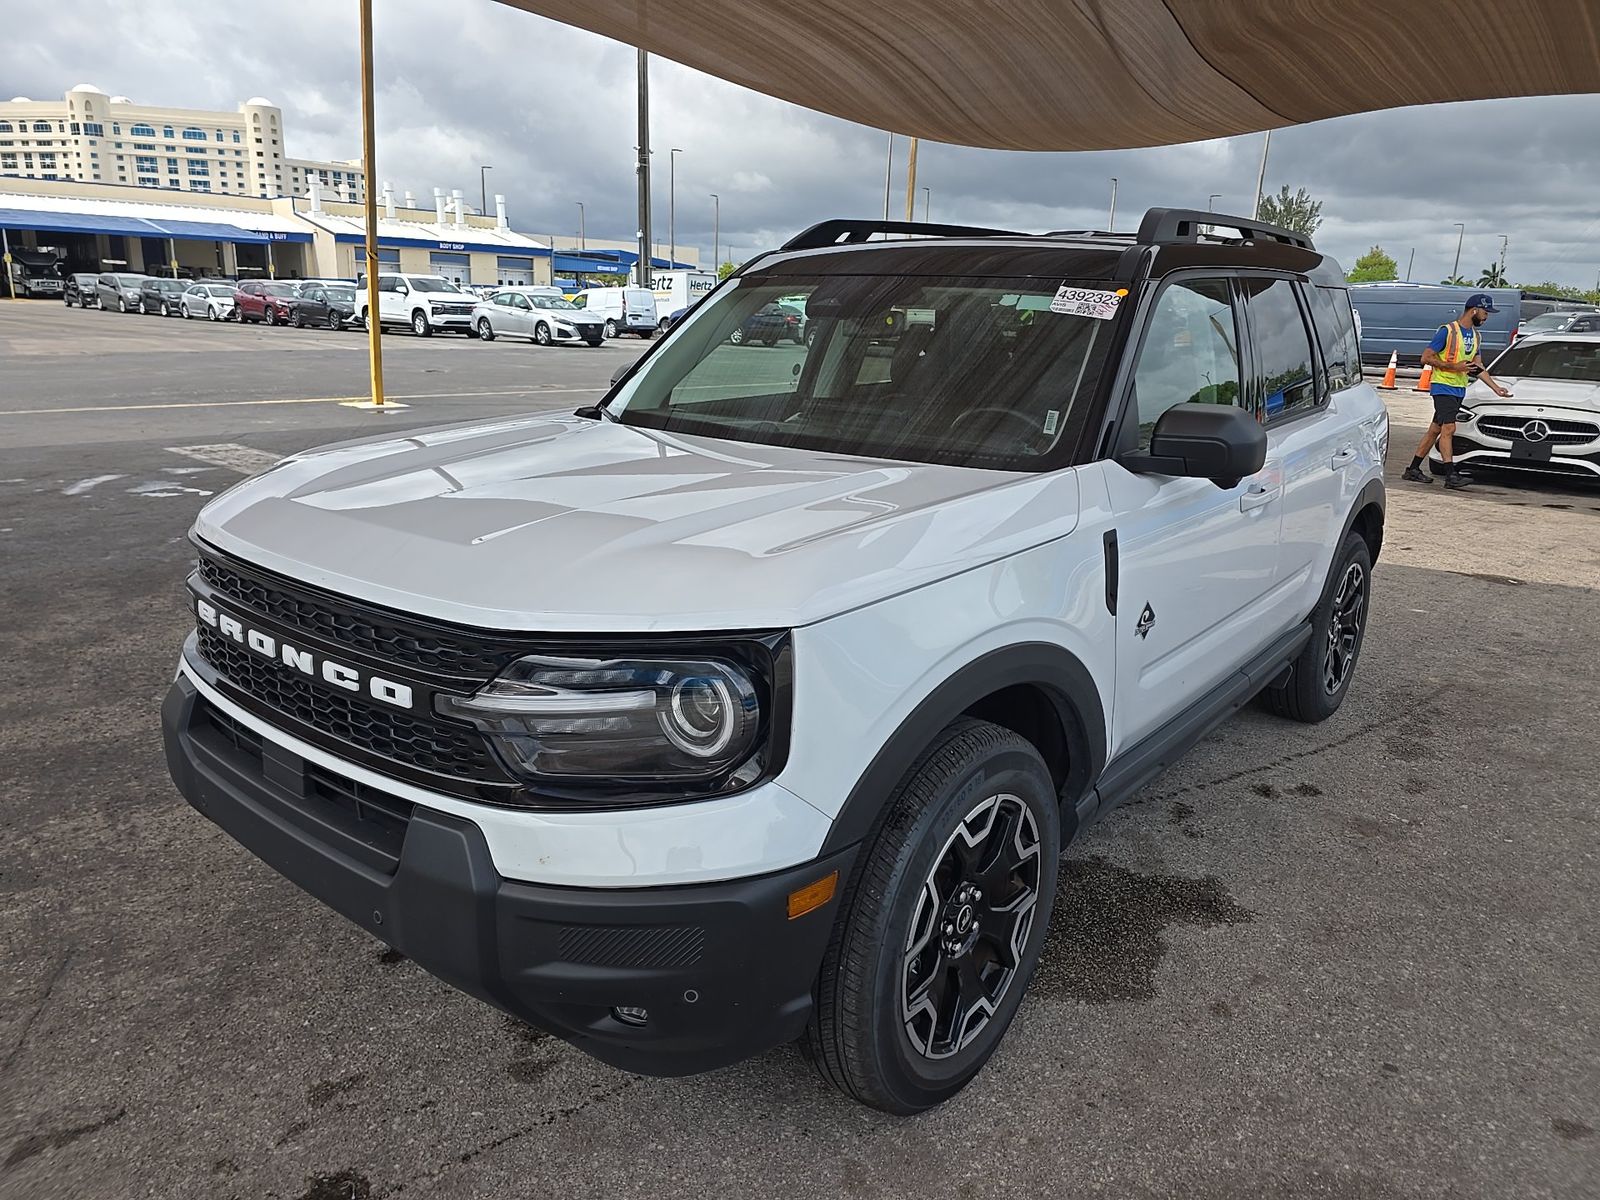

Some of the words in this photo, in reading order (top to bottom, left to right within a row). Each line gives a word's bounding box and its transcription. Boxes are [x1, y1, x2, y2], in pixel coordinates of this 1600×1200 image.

[439, 242, 452, 250] BODY
[650, 275, 673, 291] ertz
[690, 280, 713, 291] Hertz
[1058, 289, 1121, 306] 4392323
[197, 599, 413, 709] BRONCO
